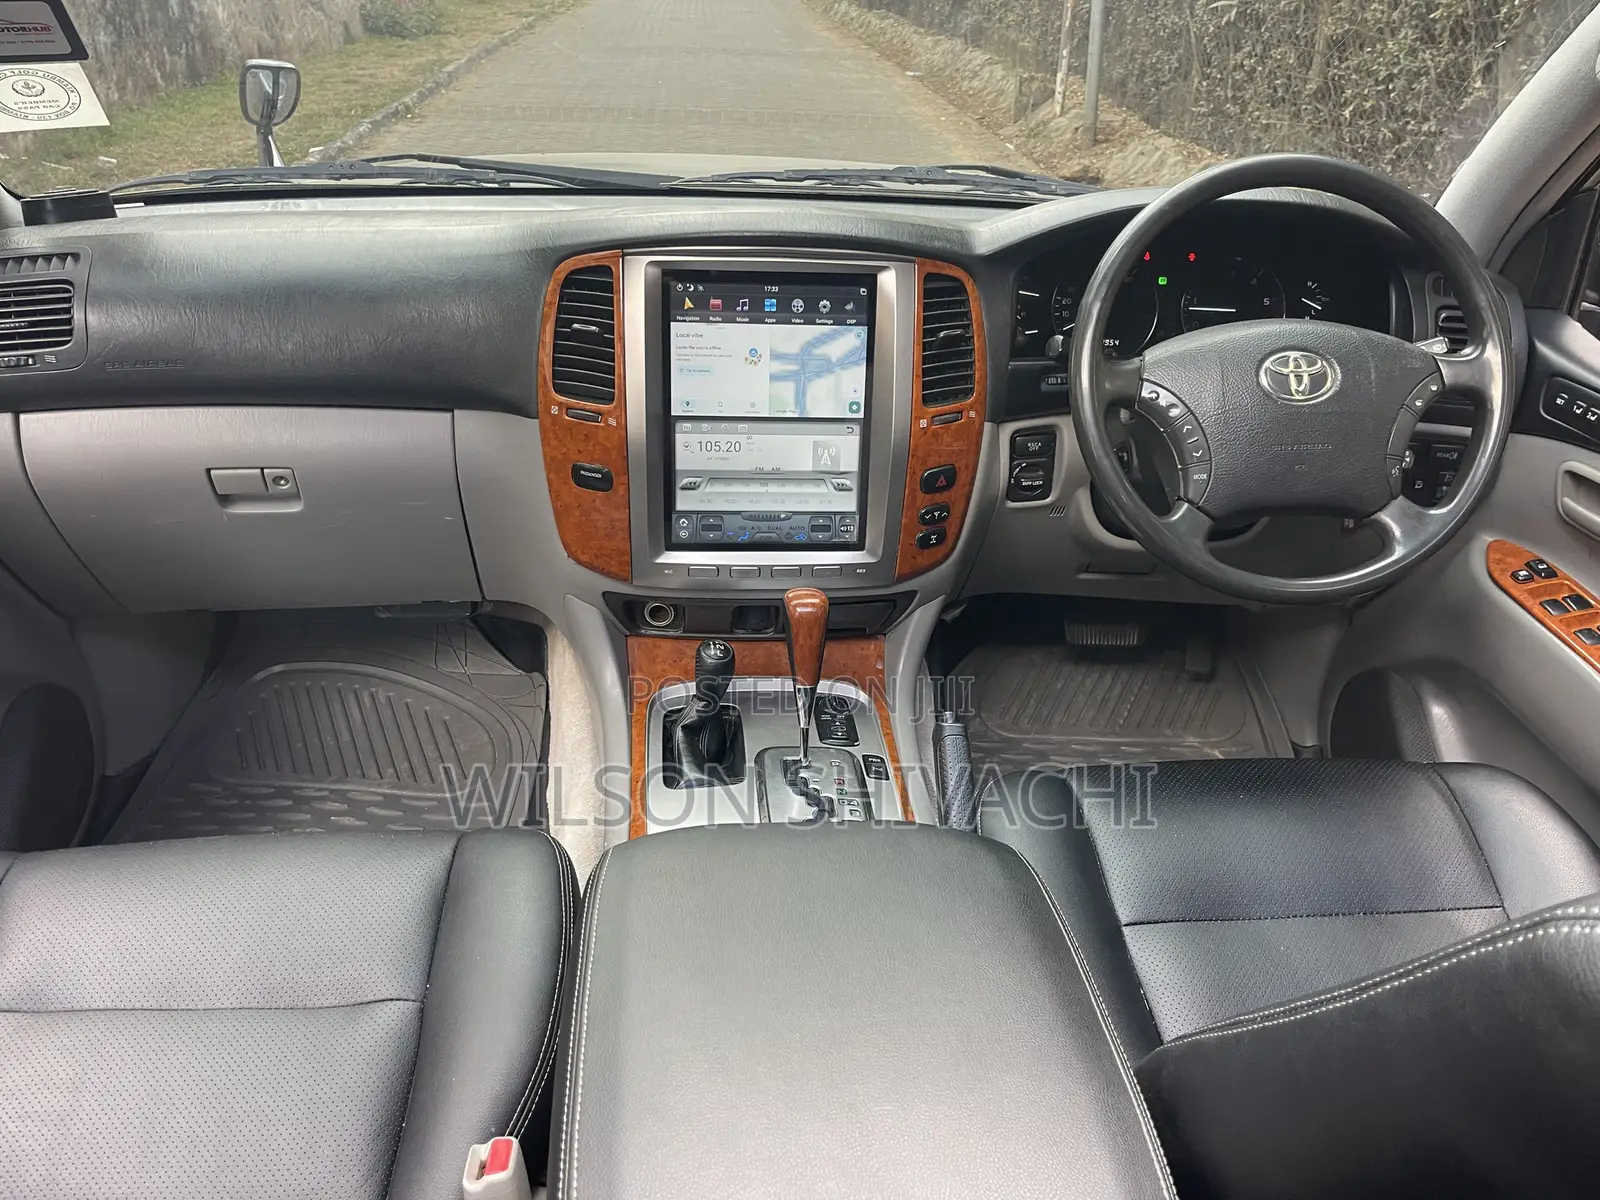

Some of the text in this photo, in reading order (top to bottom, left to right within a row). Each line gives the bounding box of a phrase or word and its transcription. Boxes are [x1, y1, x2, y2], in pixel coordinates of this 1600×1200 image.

[1263, 298, 1271, 306] 5
[1062, 310, 1070, 318] 10
[697, 440, 742, 453] 105.20
[580, 470, 602, 478] PASSENGER
